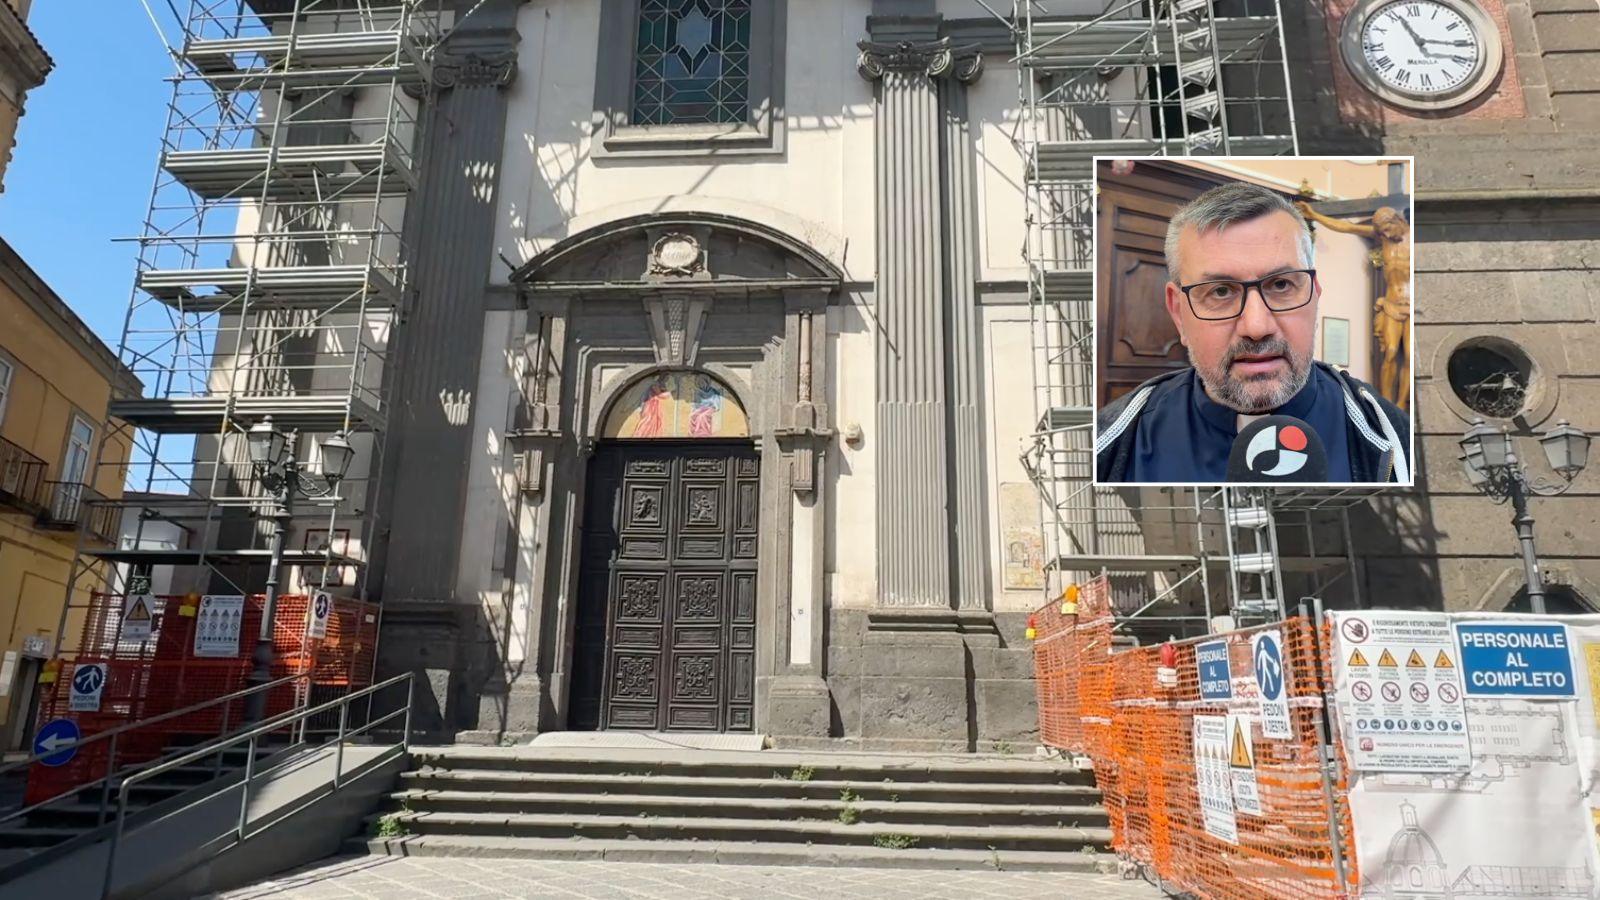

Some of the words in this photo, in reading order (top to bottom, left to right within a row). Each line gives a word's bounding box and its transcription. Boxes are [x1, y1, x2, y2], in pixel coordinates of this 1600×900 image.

[1462, 633, 1566, 648] PERSONALE
[1199, 648, 1227, 664] PERSONALE
[1506, 653, 1528, 667] AL
[1209, 665, 1217, 678] AL
[1473, 671, 1566, 687] COMPLETO
[1202, 680, 1230, 693] COMPLETO
